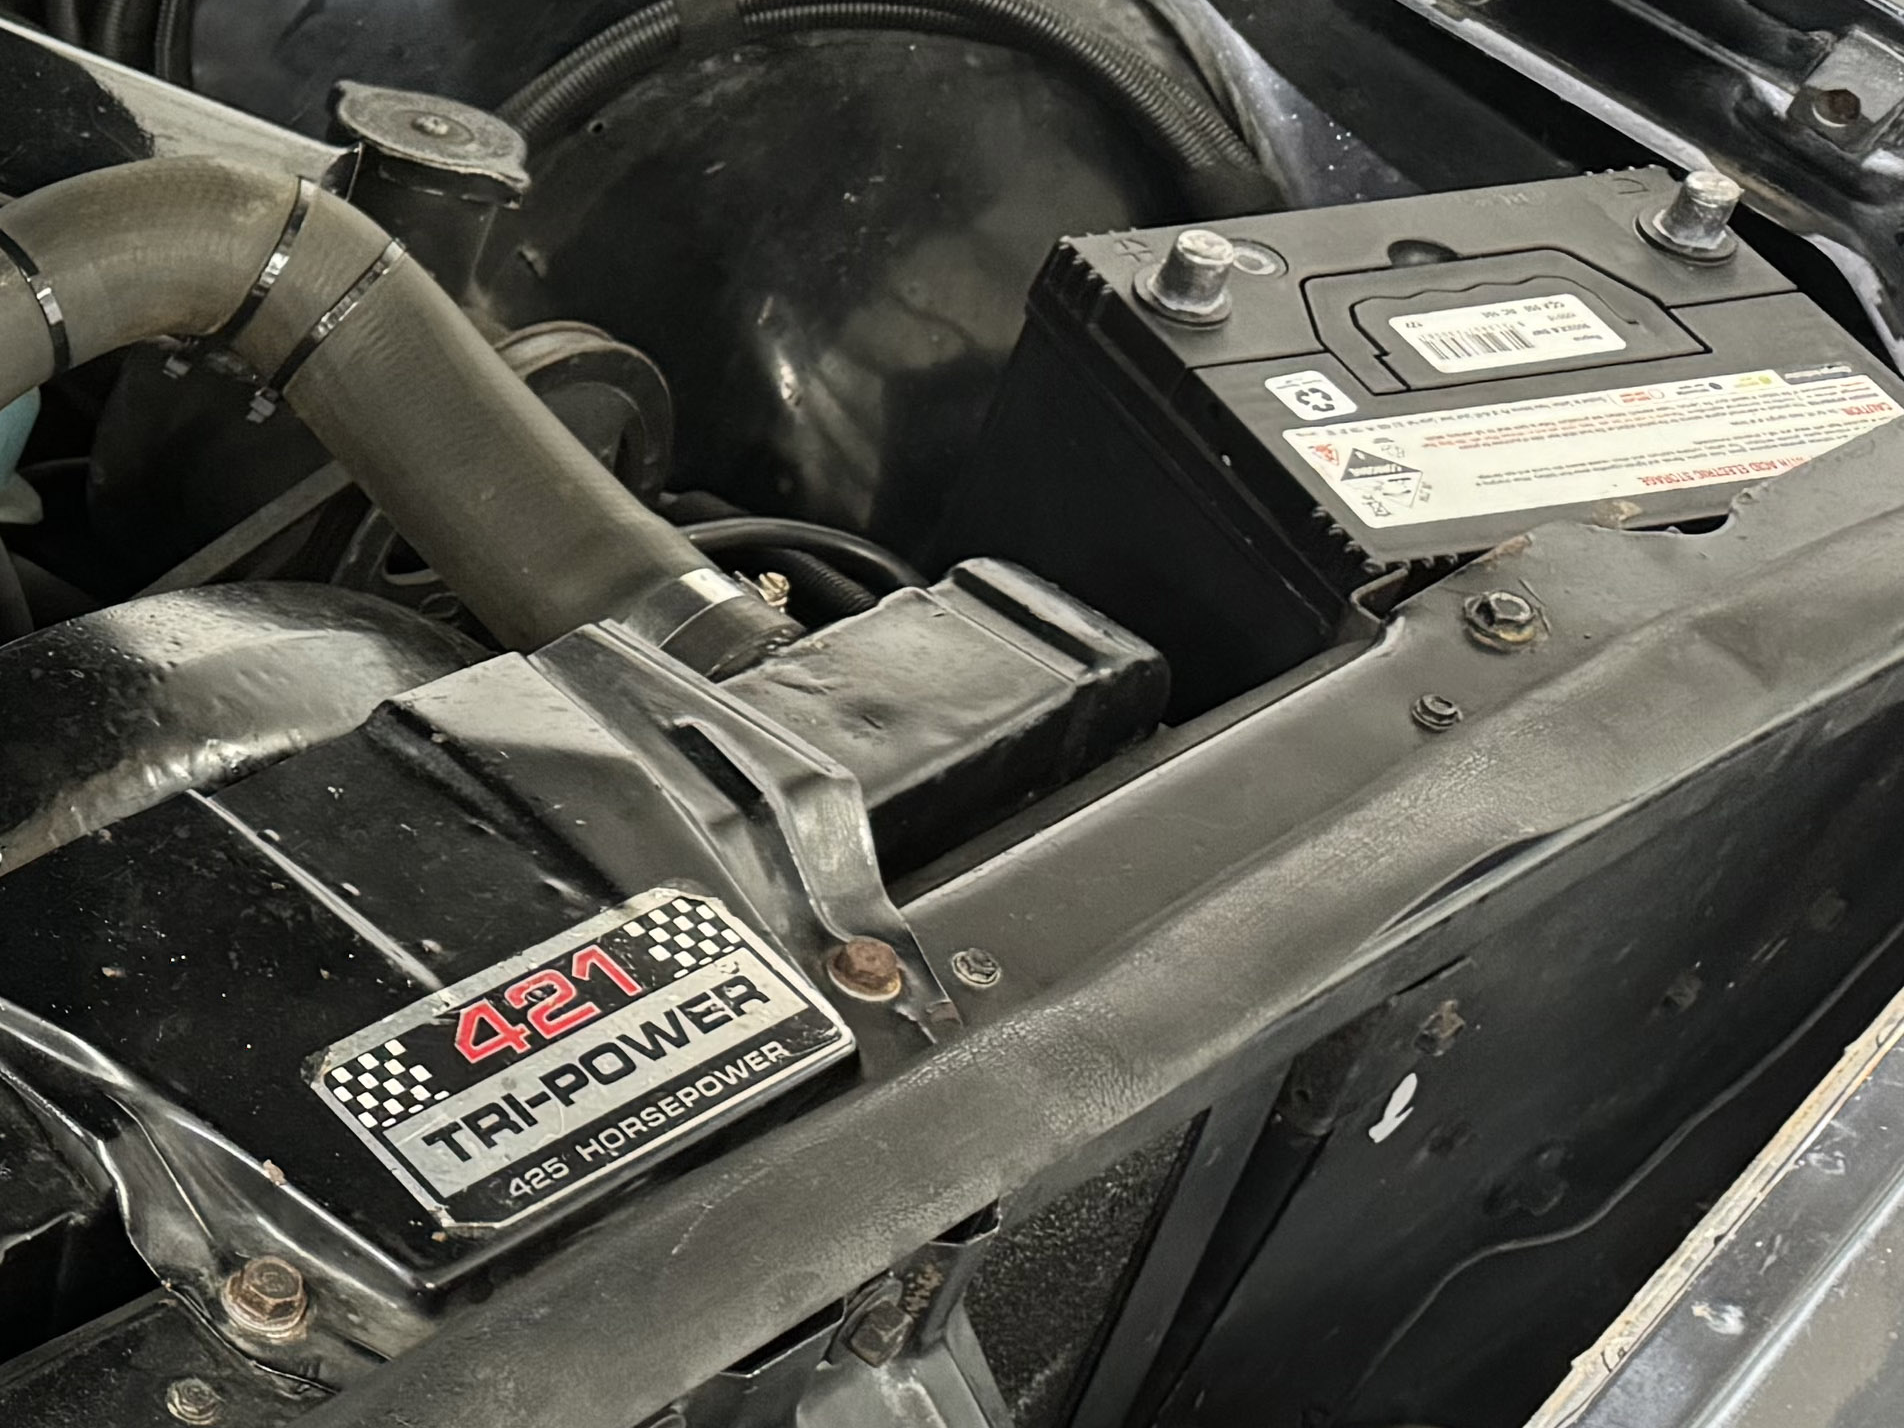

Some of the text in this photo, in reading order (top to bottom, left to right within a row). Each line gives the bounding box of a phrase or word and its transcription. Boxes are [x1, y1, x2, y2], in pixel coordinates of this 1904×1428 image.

[421, 974, 772, 1165] TRI-POWER
[454, 944, 644, 1064] 421
[507, 1039, 791, 1201] 425 HORSEPOWER
